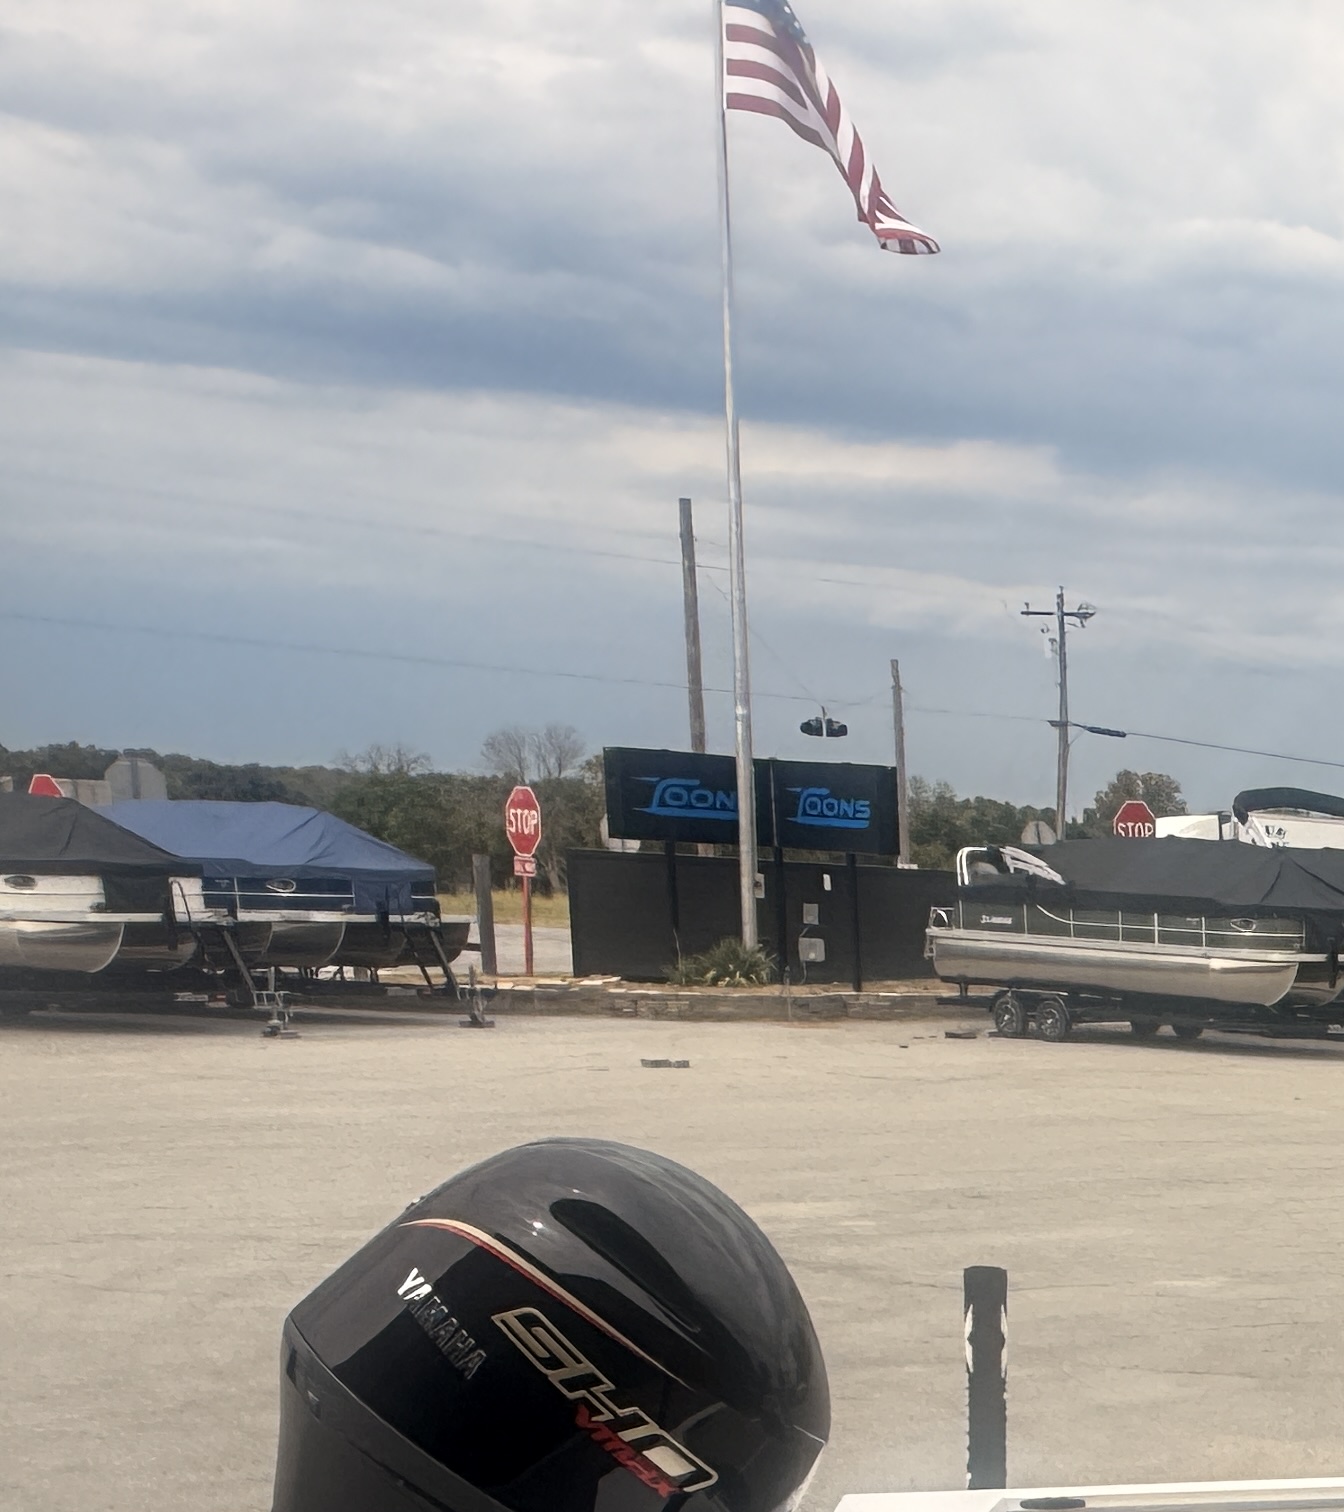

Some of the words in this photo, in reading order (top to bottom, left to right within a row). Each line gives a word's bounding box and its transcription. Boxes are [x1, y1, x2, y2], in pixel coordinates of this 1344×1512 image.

[508, 808, 538, 836] STOP
[397, 1267, 487, 1380] YAMAHA
[491, 1306, 719, 1493] SHO
